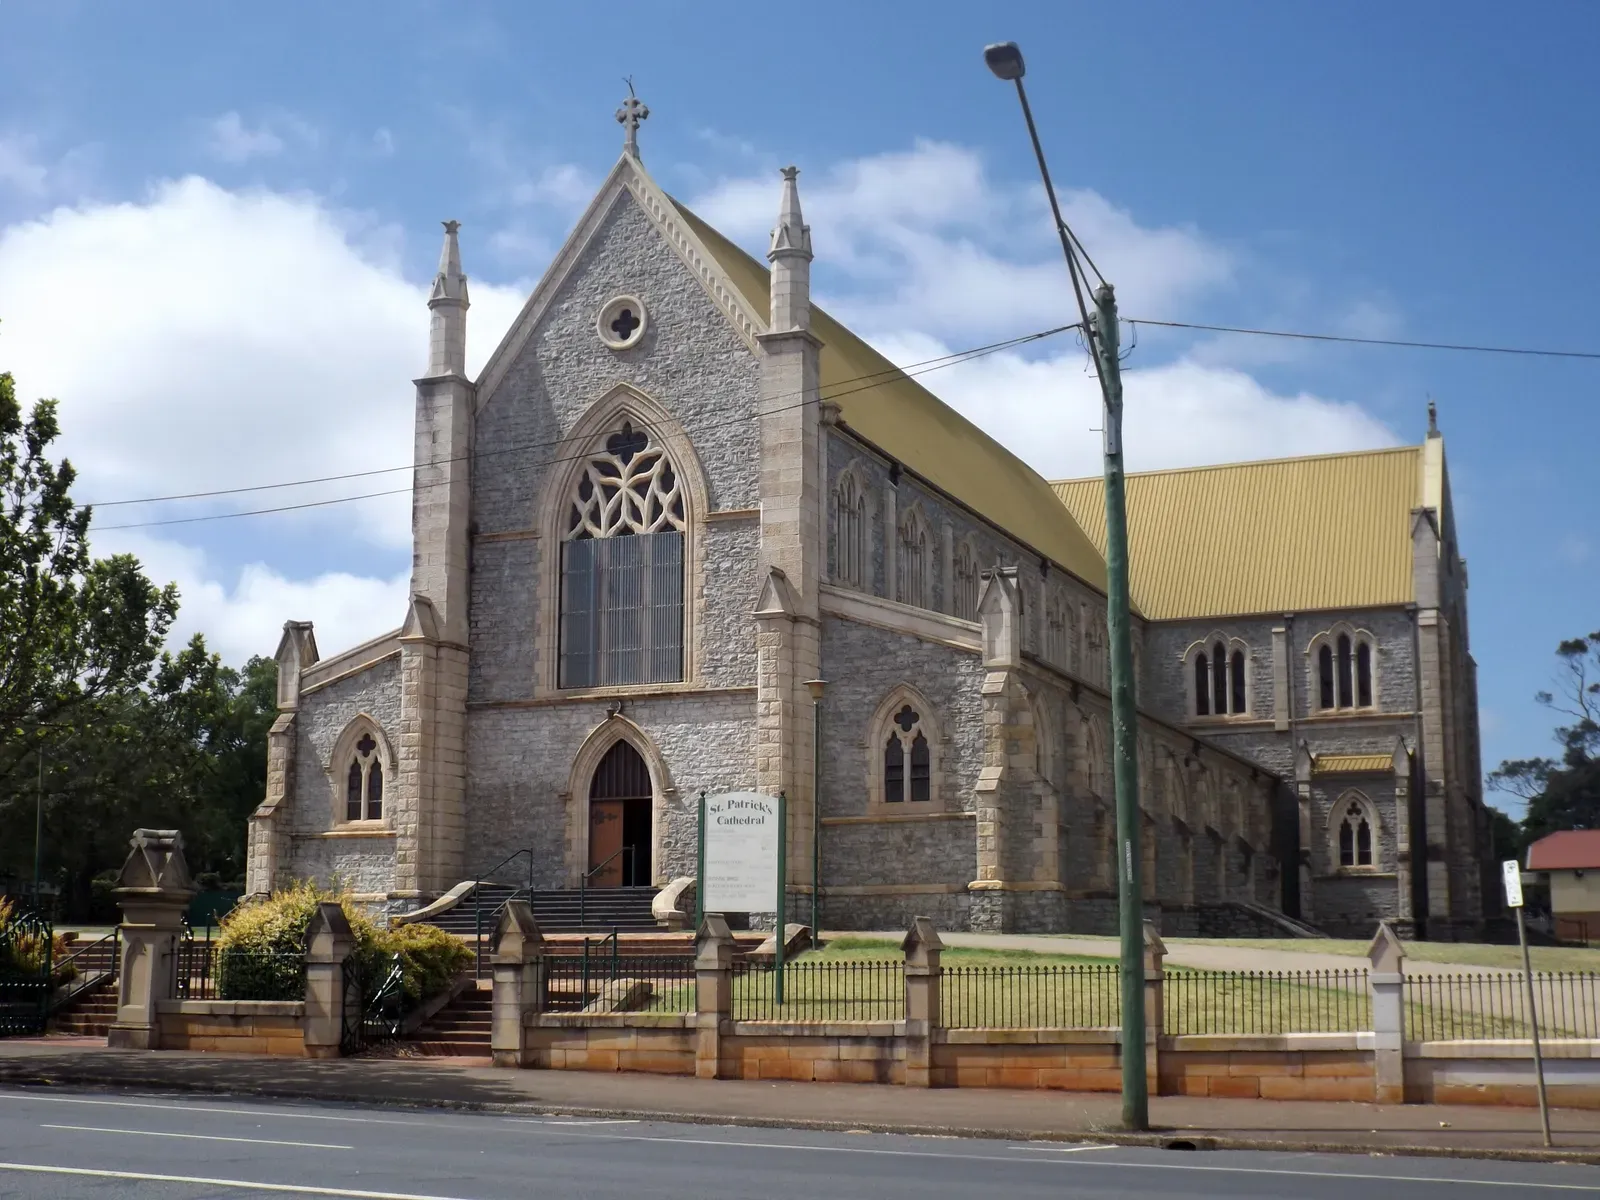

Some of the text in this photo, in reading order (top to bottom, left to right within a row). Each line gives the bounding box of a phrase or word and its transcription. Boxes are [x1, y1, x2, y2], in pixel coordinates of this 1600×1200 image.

[709, 800, 773, 815] St. Patrick's
[716, 816, 765, 825] Cathedral
